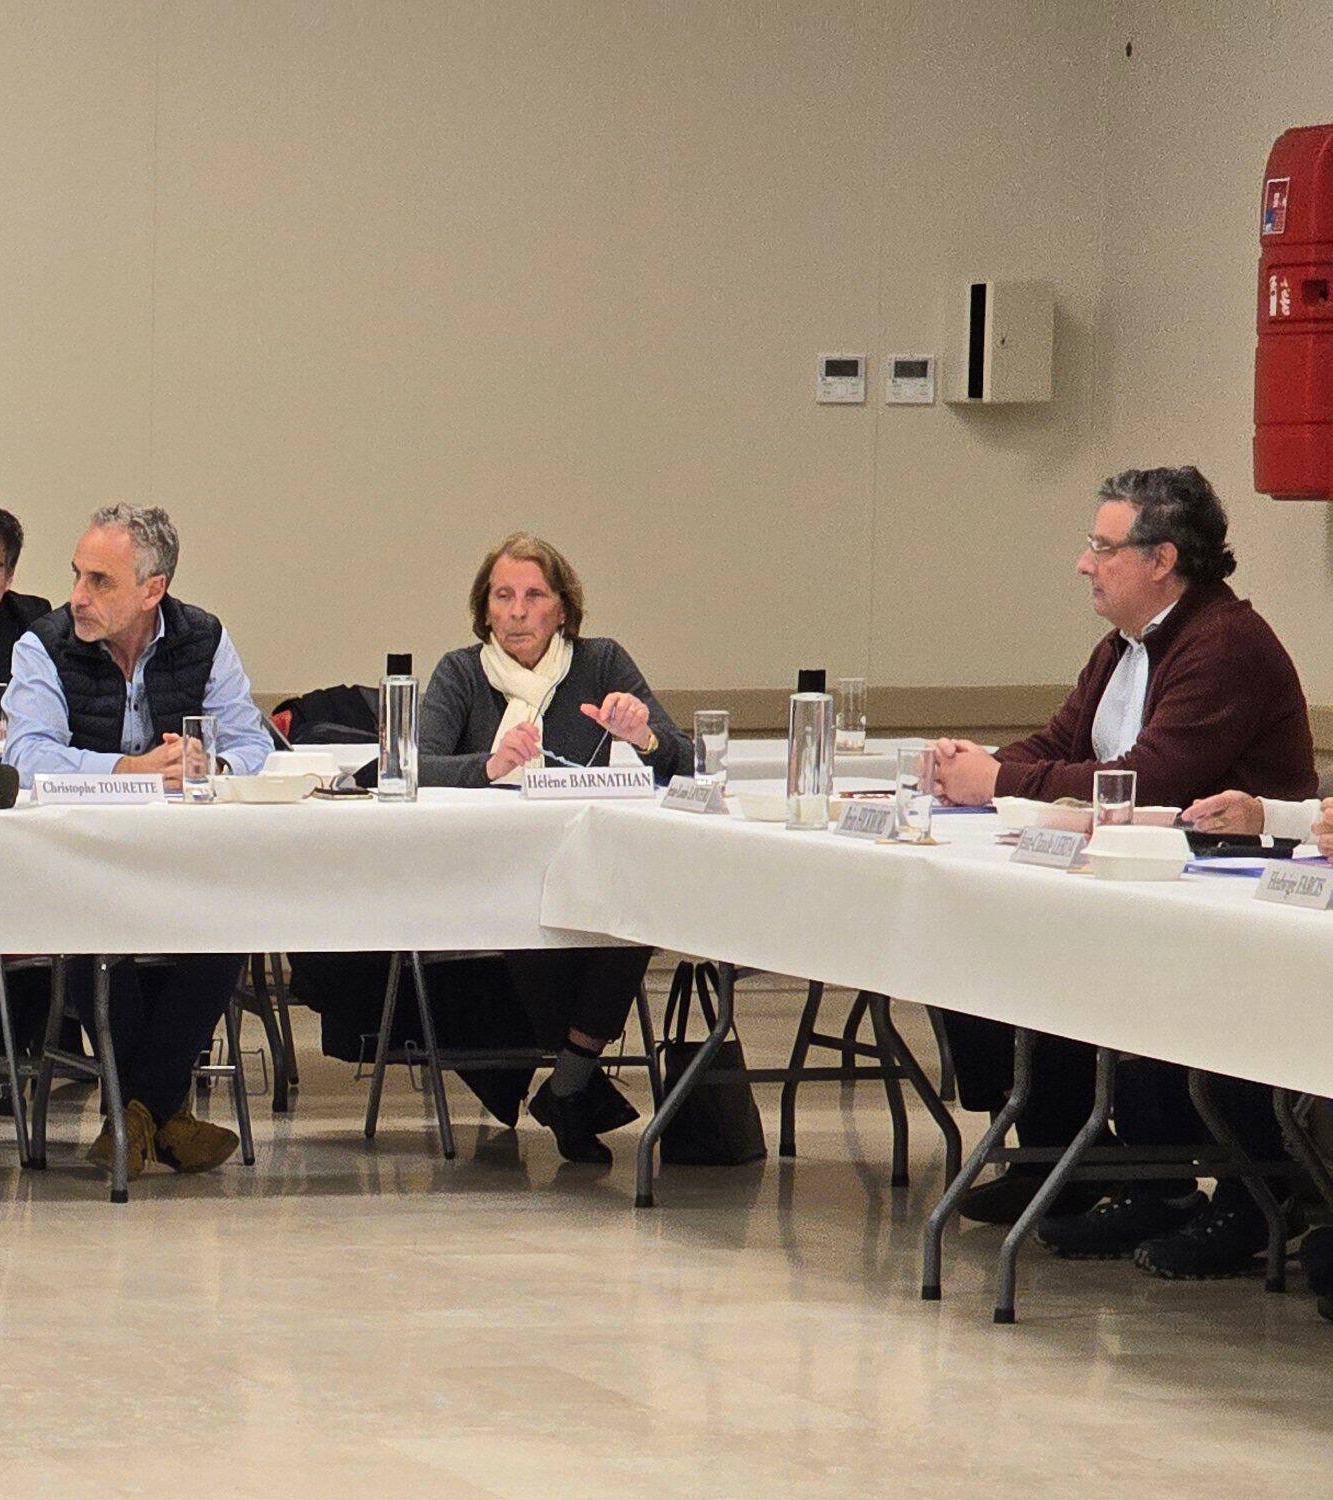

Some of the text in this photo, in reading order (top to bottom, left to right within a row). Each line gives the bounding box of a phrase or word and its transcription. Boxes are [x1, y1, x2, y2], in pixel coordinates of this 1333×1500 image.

[42, 780, 158, 797] Christophe TOURETTE
[527, 772, 651, 789] Hélène BARNATHAN
